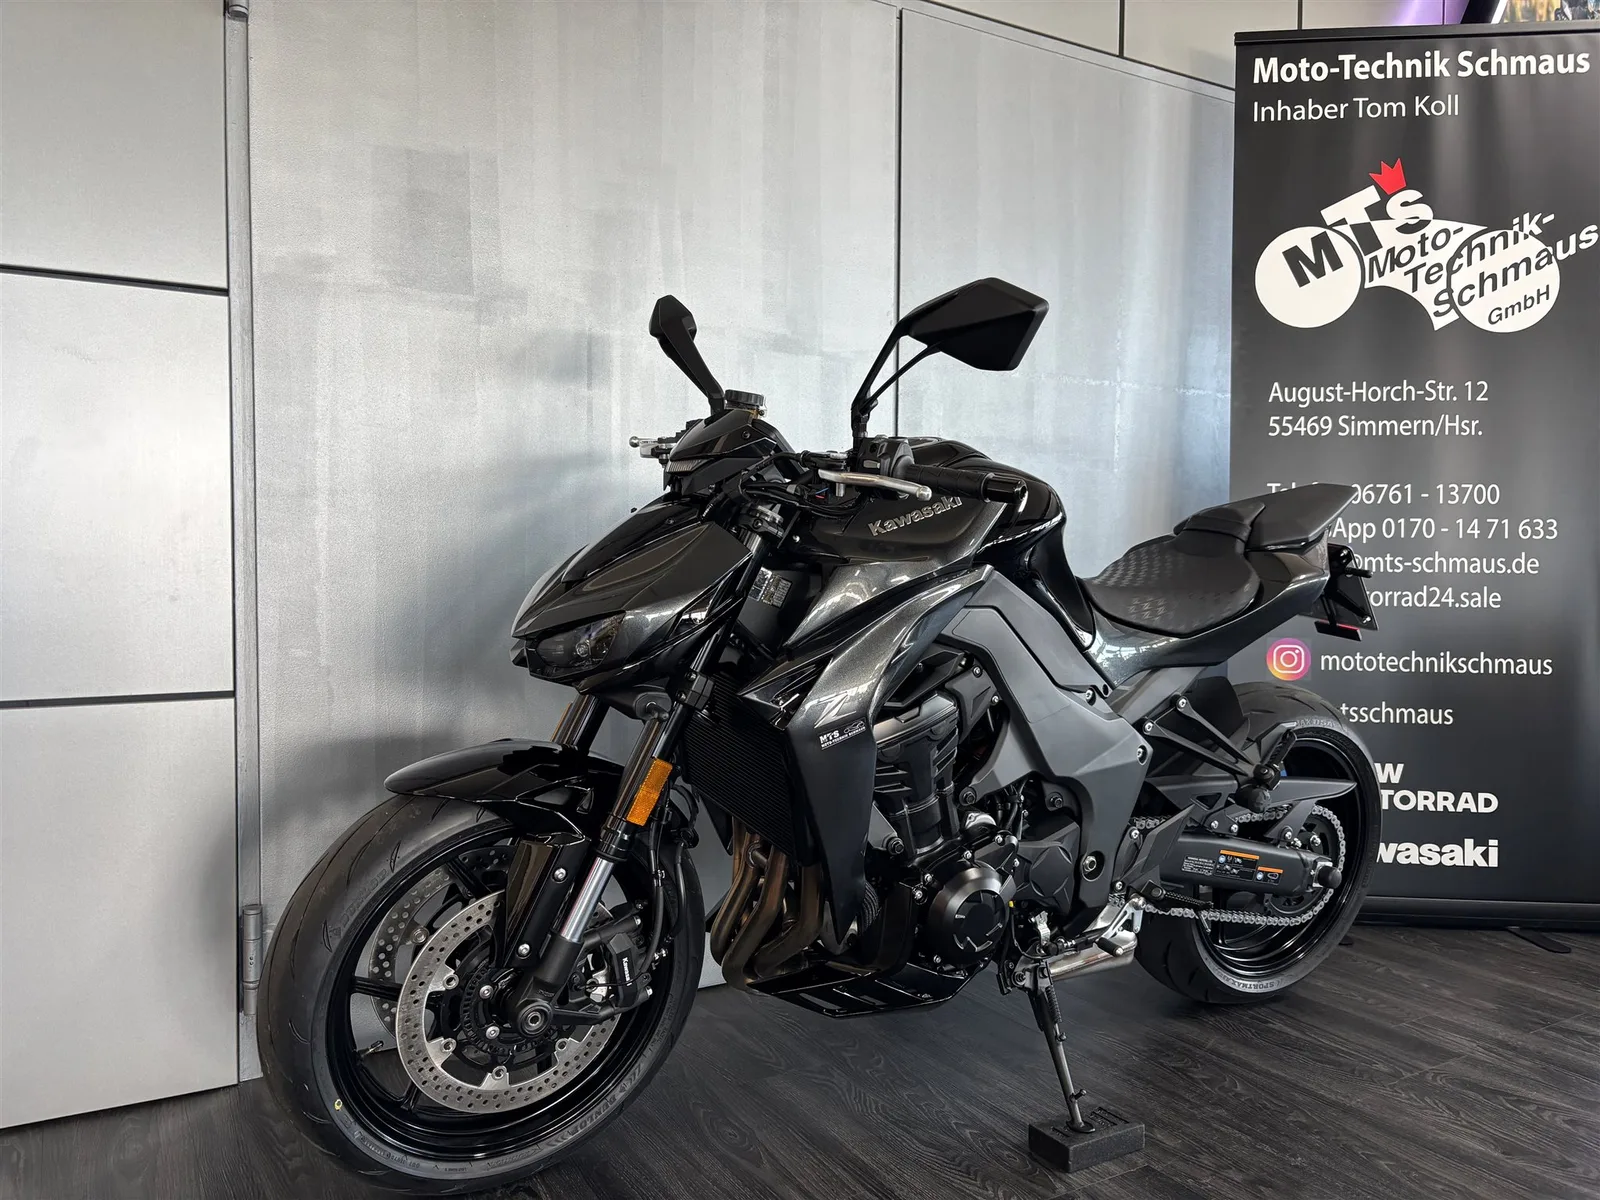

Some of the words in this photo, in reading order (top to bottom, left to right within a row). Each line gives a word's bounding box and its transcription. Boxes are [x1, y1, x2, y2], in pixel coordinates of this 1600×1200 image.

[1252, 51, 1451, 84] Moto-Technik
[1457, 48, 1591, 77] Schmaus
[1252, 100, 1349, 122] Inhaber
[1352, 98, 1406, 119] Tom
[1414, 94, 1460, 117] Koll
[1282, 185, 1434, 288] MTS
[1367, 226, 1464, 284] Moto-
[1403, 212, 1556, 294] Technik-
[1432, 224, 1600, 319] Schmaus
[1487, 284, 1551, 326] GmbH
[1268, 380, 1458, 407] August-Horch-Str.
[1464, 380, 1489, 401] 12
[1267, 416, 1333, 437] 55469
[1338, 414, 1484, 437] Simmern/Hsr.
[1435, 484, 1501, 505] 13700
[867, 496, 963, 537] Kawasaki
[1328, 517, 1376, 543] App
[1381, 517, 1436, 539] 0170
[1455, 519, 1481, 539] 14
[1486, 519, 1511, 540] 71
[1517, 519, 1559, 540] 633
[1367, 586, 1502, 609] orrad24.sale
[1320, 650, 1553, 675] mototechnikschmaus
[1340, 701, 1454, 725] tsschmaus
[819, 730, 840, 744] MTS
[1381, 790, 1499, 813] TORRAD
[1376, 838, 1499, 868] wasaki
